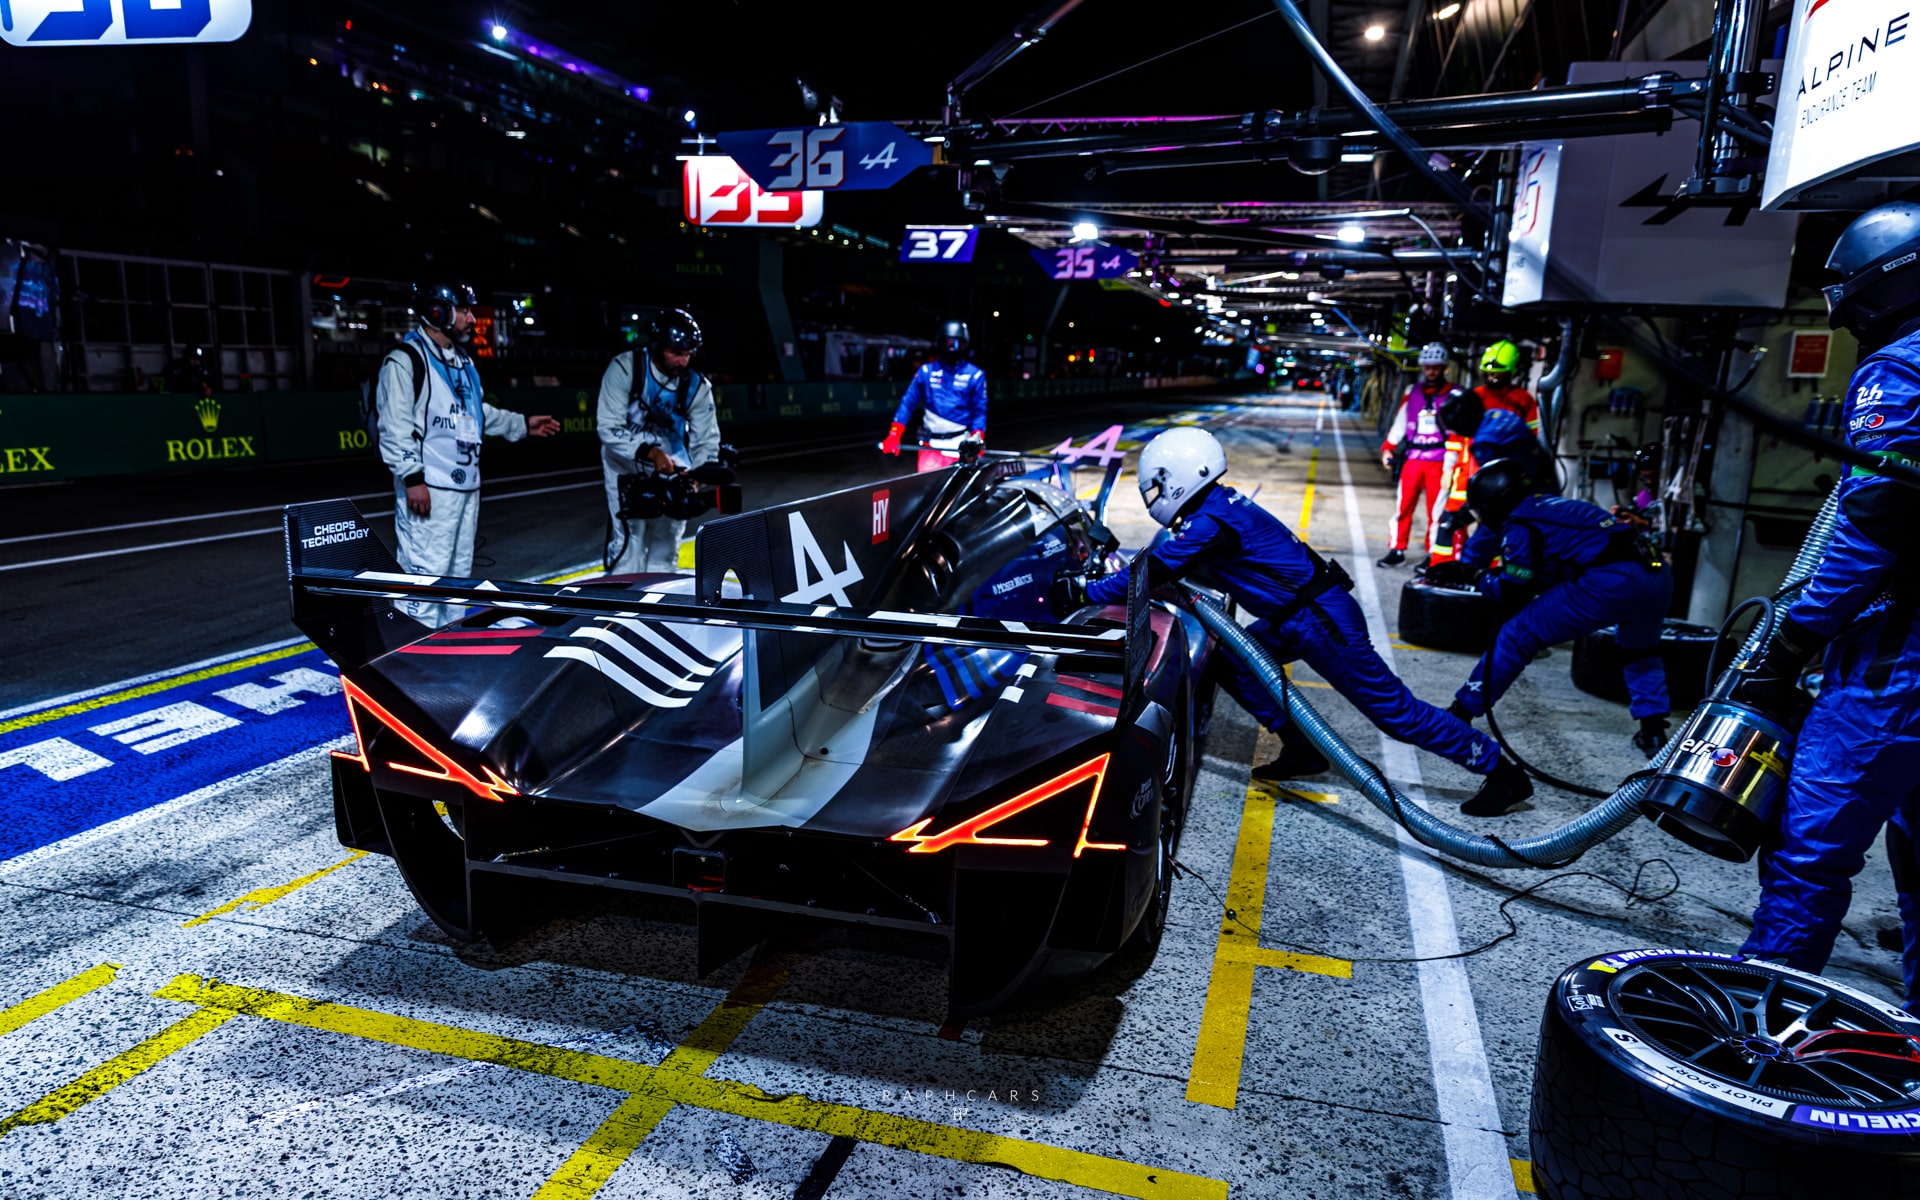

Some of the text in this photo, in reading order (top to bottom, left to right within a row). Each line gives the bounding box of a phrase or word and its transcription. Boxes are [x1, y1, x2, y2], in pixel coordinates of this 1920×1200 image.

[1796, 12, 1910, 101] ALPINE
[1801, 71, 1878, 128] ENDURANCE TEAM
[767, 127, 846, 189] 36
[908, 231, 968, 259] 37
[1054, 247, 1096, 280] 35
[564, 416, 597, 433] ROLE
[167, 436, 256, 462] ROLEX
[339, 431, 371, 450] RO
[313, 520, 356, 536] CHEOPS
[873, 498, 890, 535] HY
[301, 527, 370, 549] TECHNOLOGY
[1679, 738, 1716, 756] elf
[1623, 949, 1733, 962] MICHELIN
[1666, 1064, 1774, 1108] PILOT SPORT
